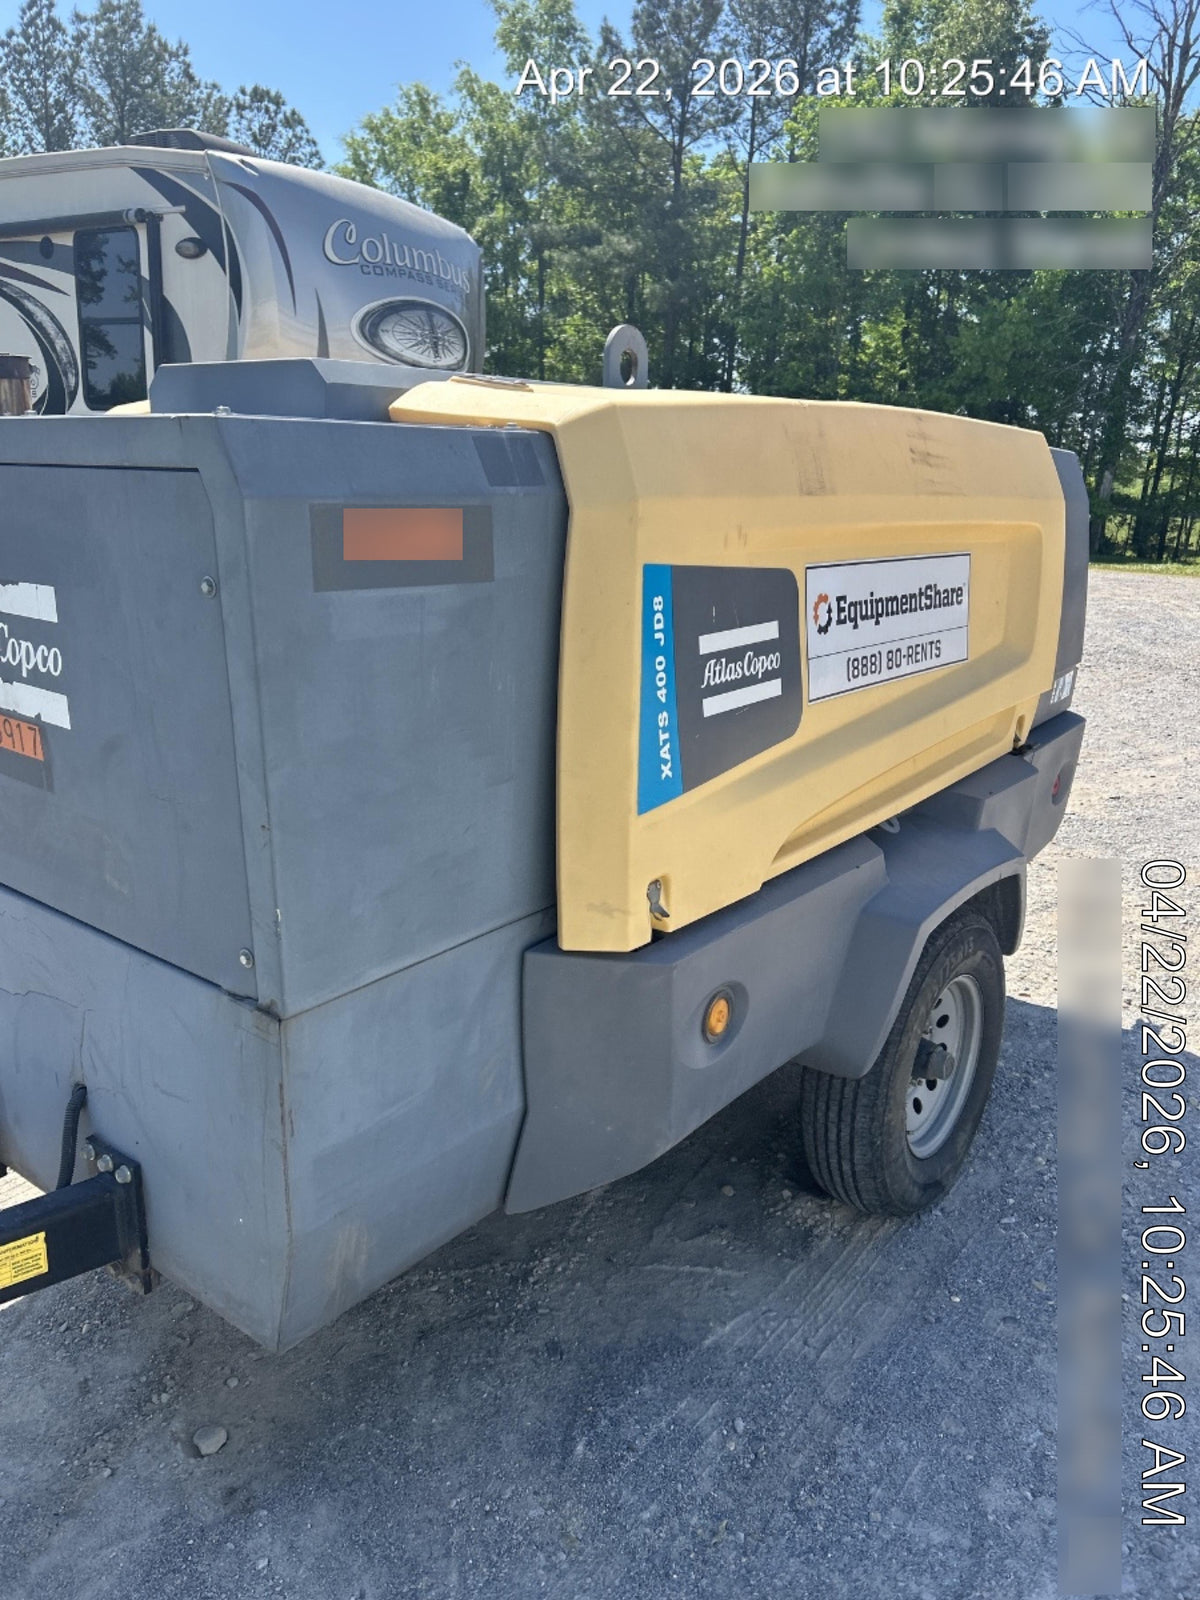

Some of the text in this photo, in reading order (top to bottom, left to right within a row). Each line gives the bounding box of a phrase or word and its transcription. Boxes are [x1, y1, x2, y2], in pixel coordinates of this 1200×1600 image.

[323, 218, 470, 294] Columbus
[360, 264, 434, 286] COMPASS
[835, 583, 964, 630] EquipmentShare
[846, 639, 942, 682] (888) 80-RENTS
[652, 595, 673, 781] XATS 400 JD8
[0, 717, 38, 757] 917
